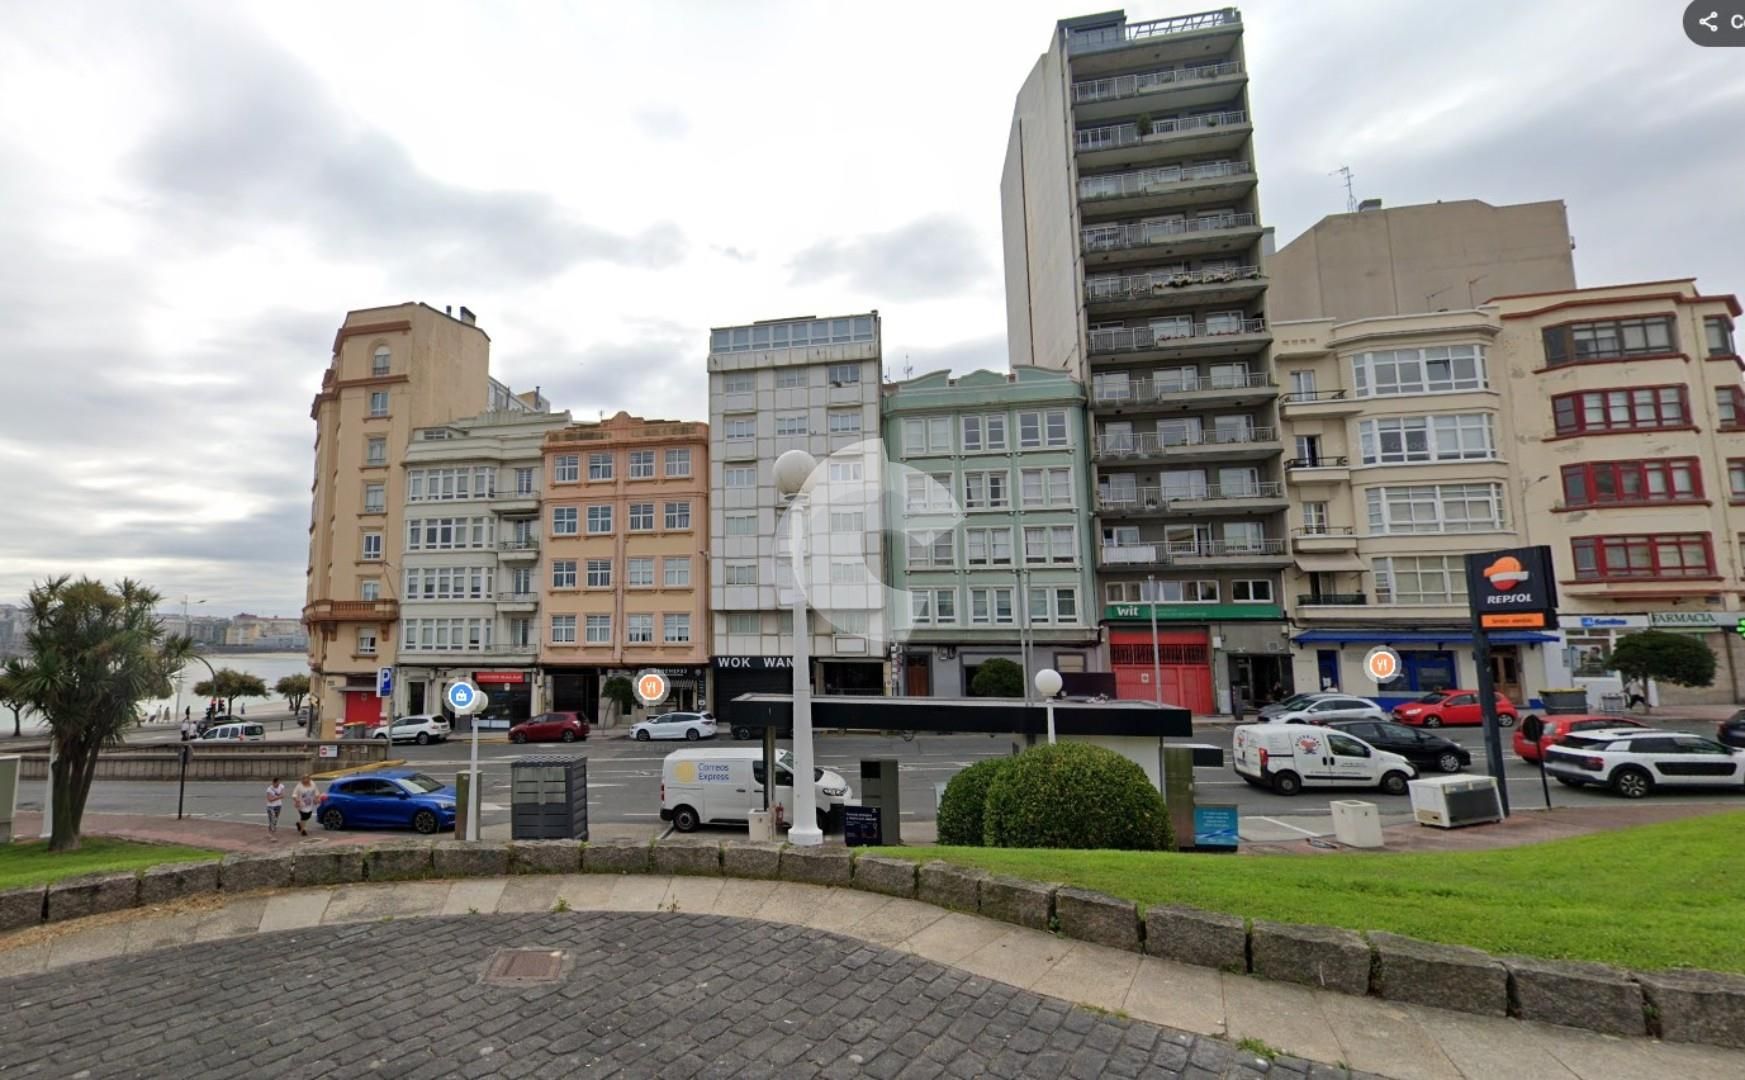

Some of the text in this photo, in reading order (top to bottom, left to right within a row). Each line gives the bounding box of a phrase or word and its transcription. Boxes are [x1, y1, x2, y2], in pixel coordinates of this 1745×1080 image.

[1487, 593, 1533, 605] REPSOL
[1652, 612, 1716, 623] FARMACIA
[718, 657, 751, 668] WOK
[380, 668, 390, 688] P
[698, 762, 729, 771] Correos
[698, 773, 729, 782] Express
